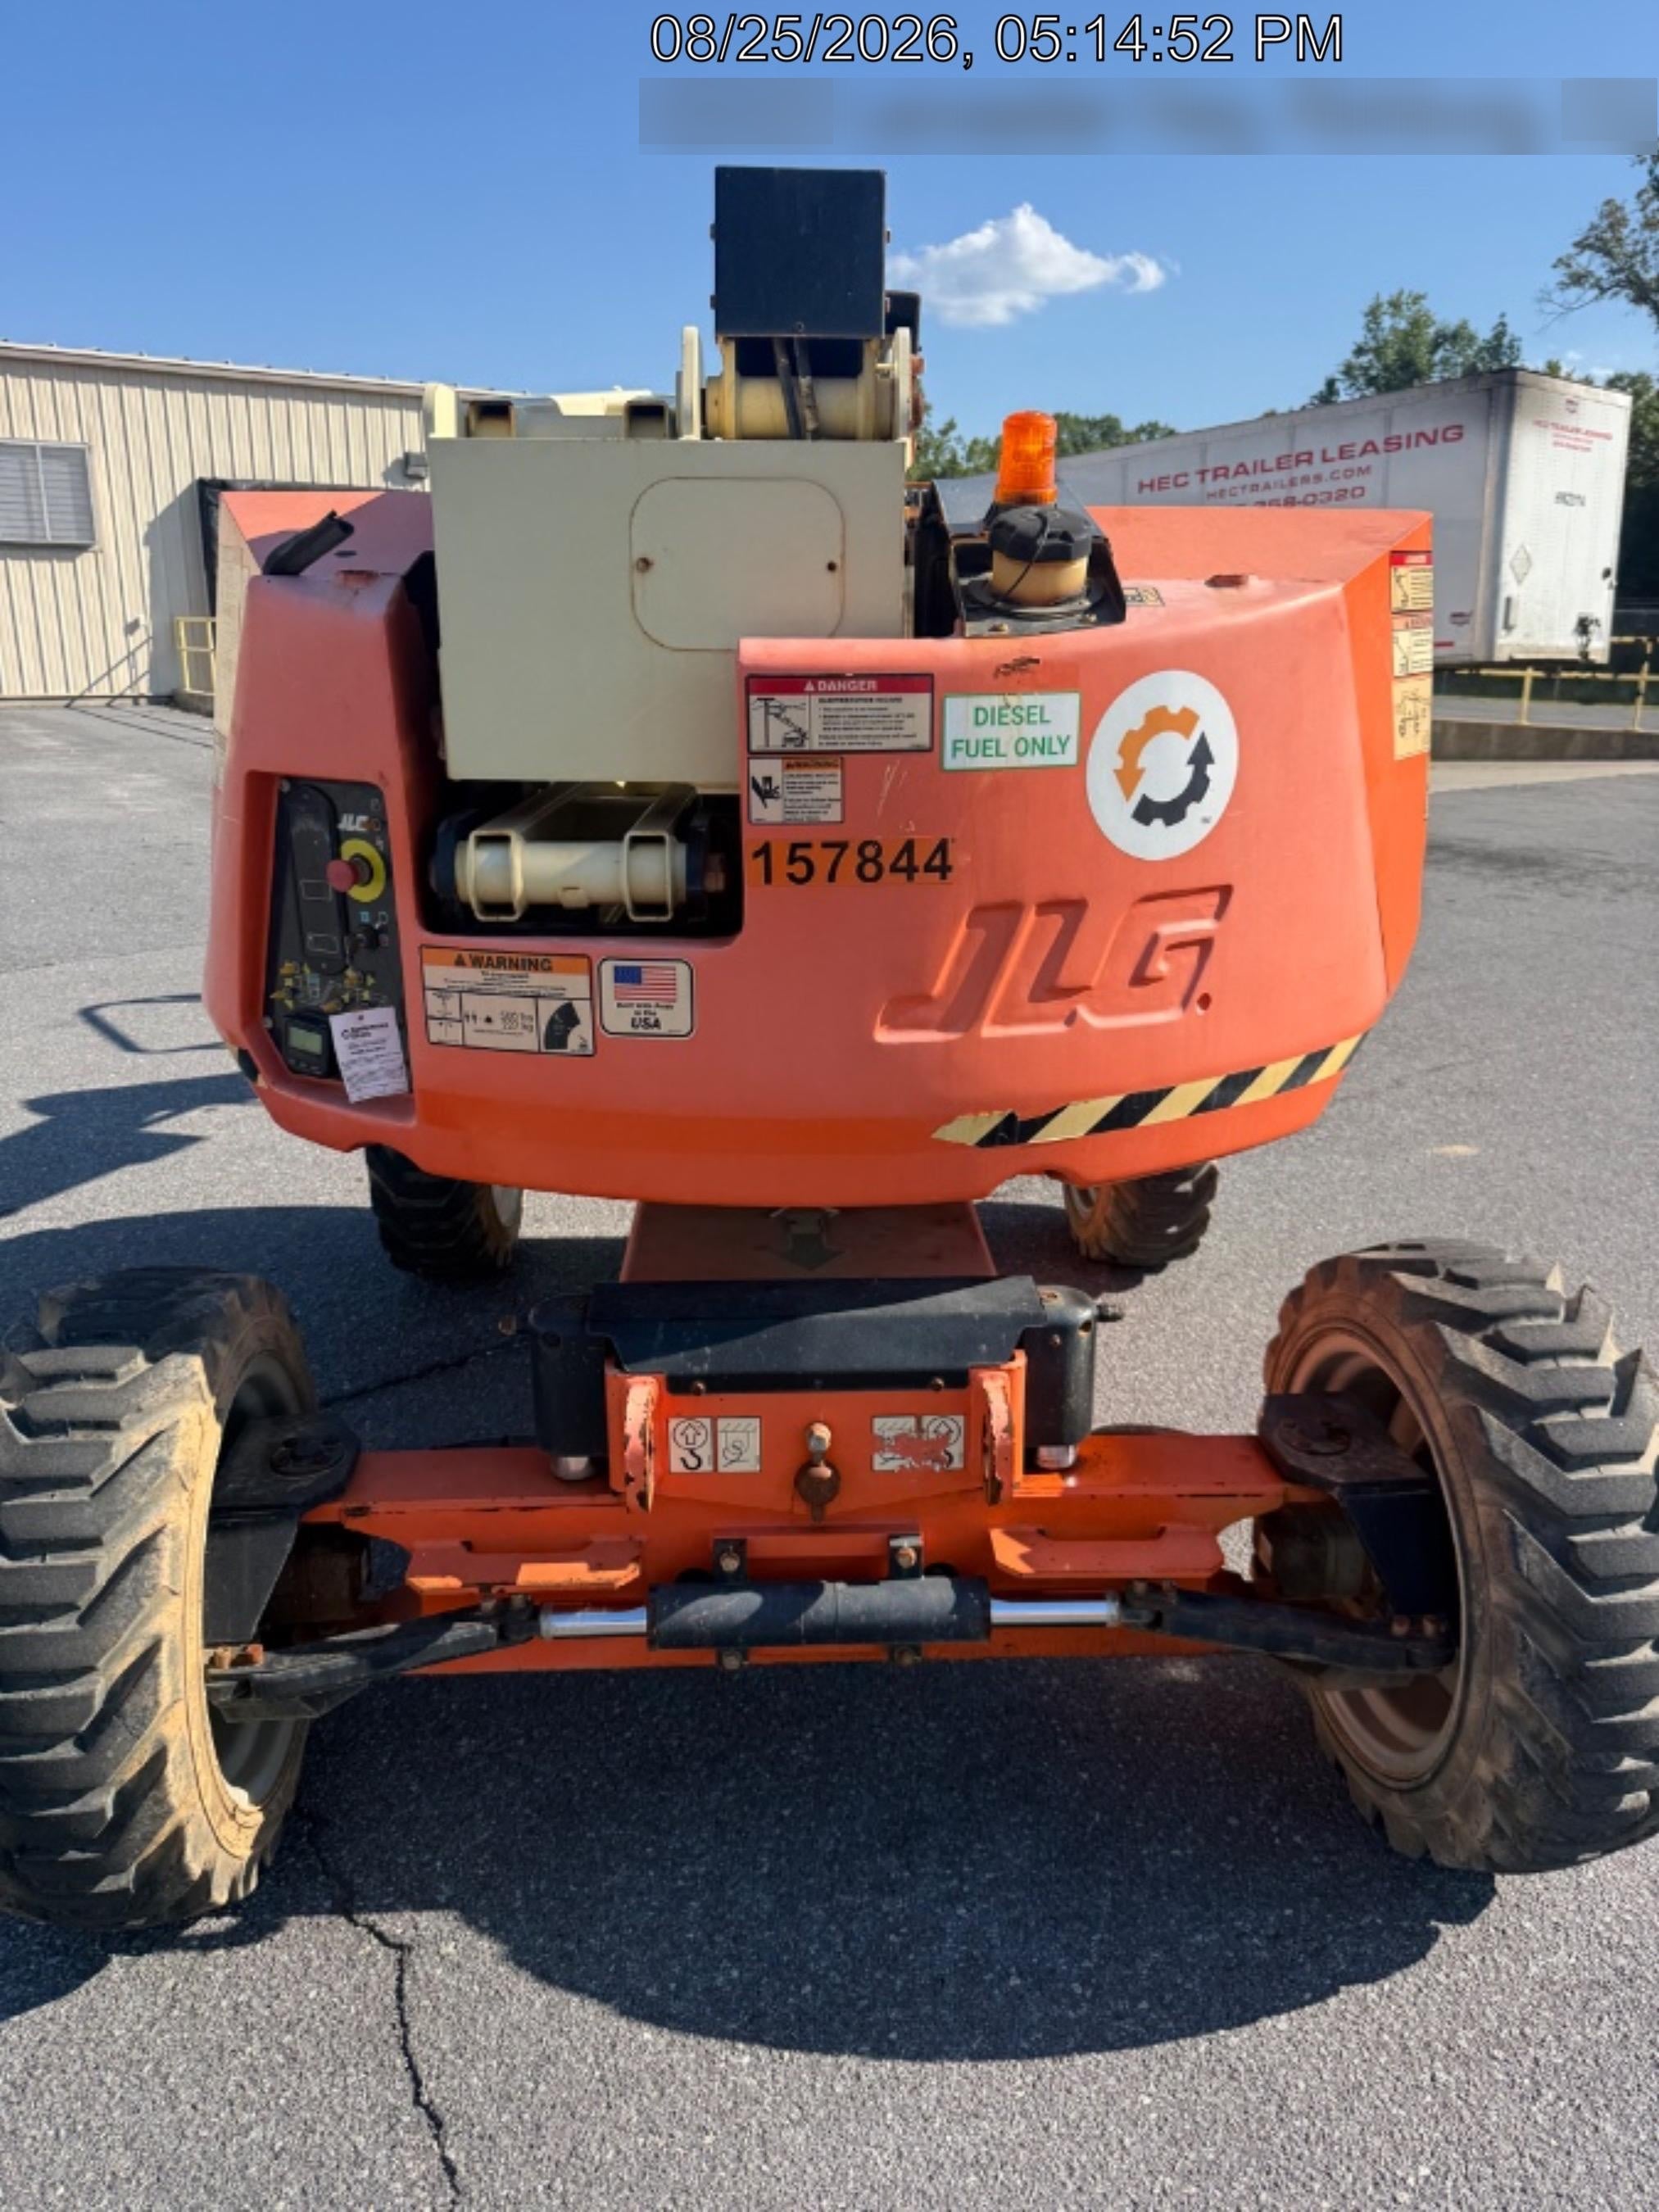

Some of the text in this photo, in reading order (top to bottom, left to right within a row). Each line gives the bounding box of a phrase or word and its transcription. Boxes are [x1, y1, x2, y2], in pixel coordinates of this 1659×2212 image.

[1138, 424, 1465, 494] HEC TRAILER LEASING
[1206, 465, 1372, 501] HECTRAILERS.COM
[818, 680, 878, 691] DANGER
[973, 705, 1052, 727] DIESEL
[950, 734, 1071, 759] FUEL ONLY
[751, 837, 954, 886] 157844
[469, 954, 553, 972] WARNING
[630, 1017, 662, 1031] USA
